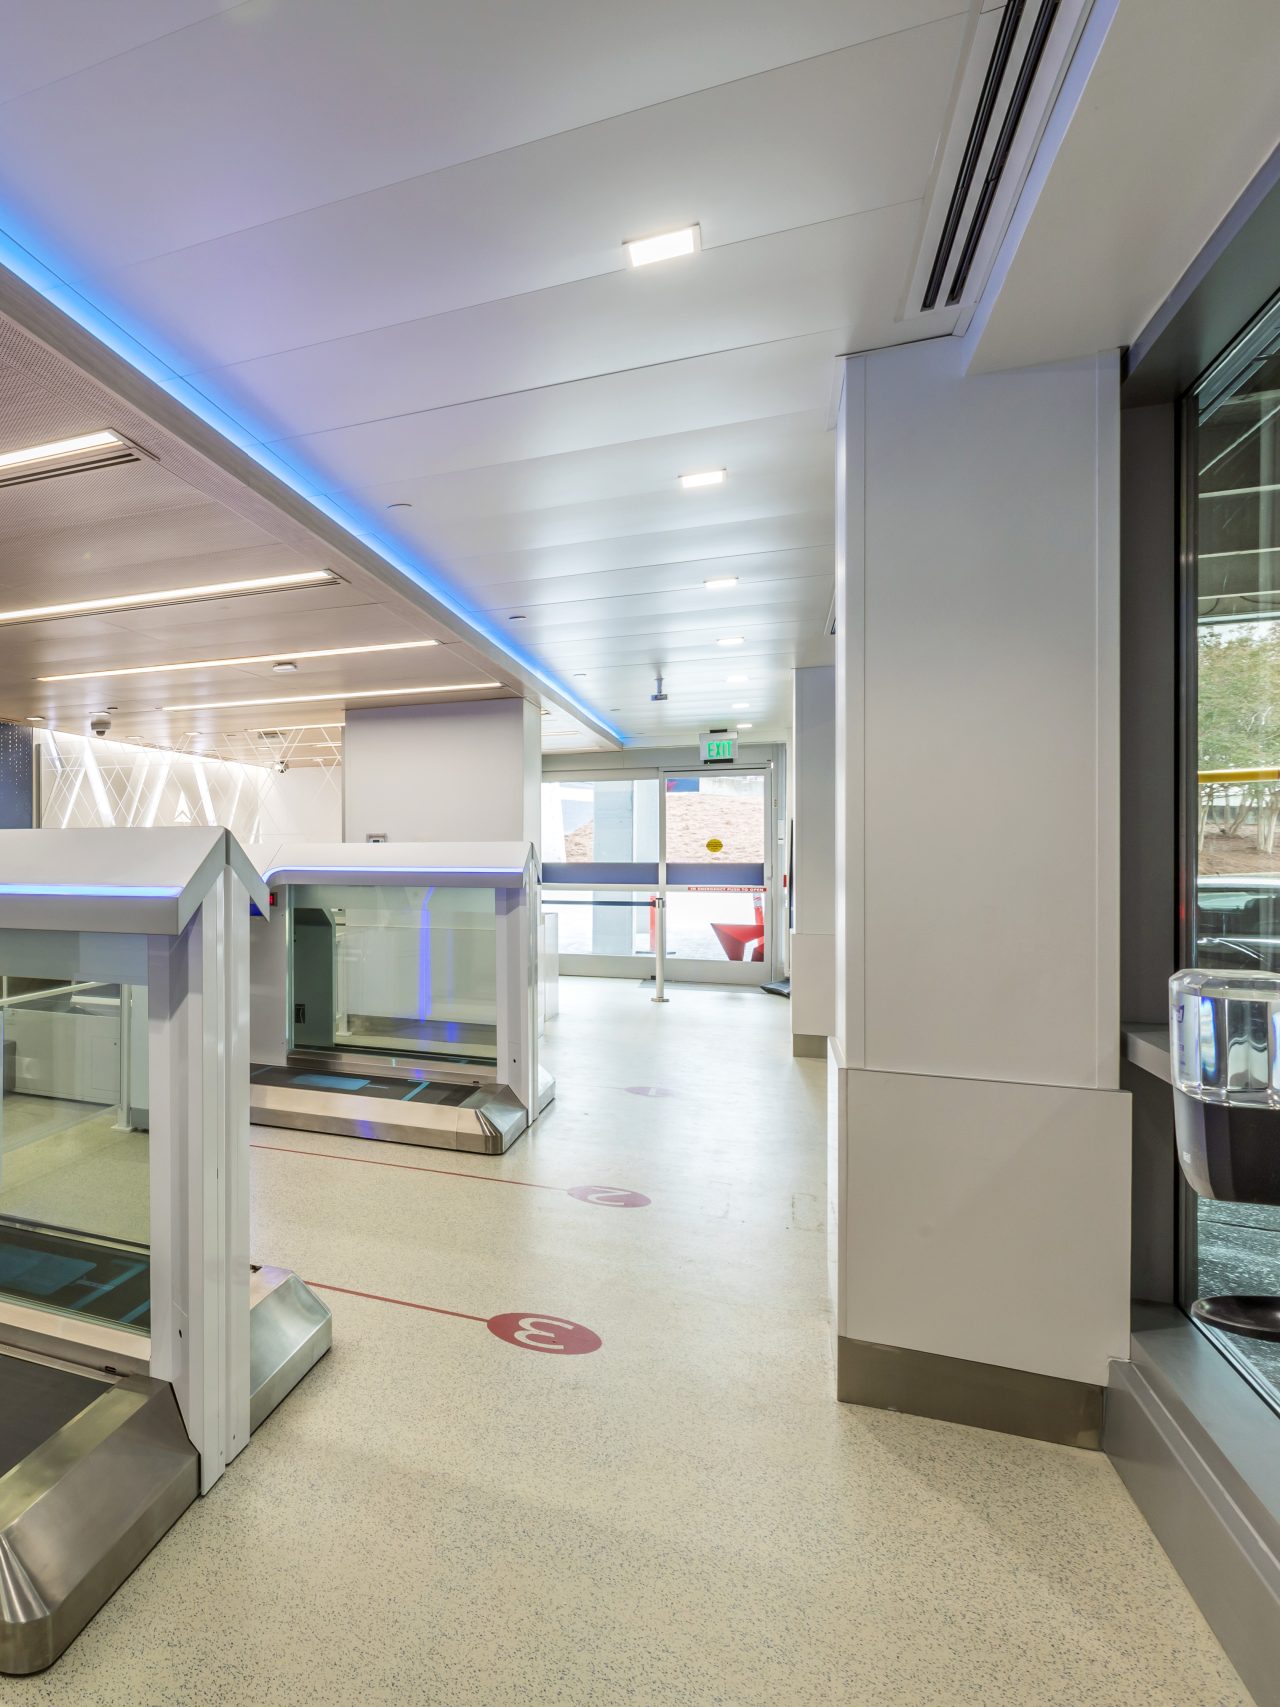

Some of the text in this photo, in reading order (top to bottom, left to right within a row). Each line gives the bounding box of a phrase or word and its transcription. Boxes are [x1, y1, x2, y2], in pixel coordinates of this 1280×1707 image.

[707, 741, 733, 759] EXIT
[586, 1186, 632, 1206] 2
[513, 1317, 574, 1350] 3
